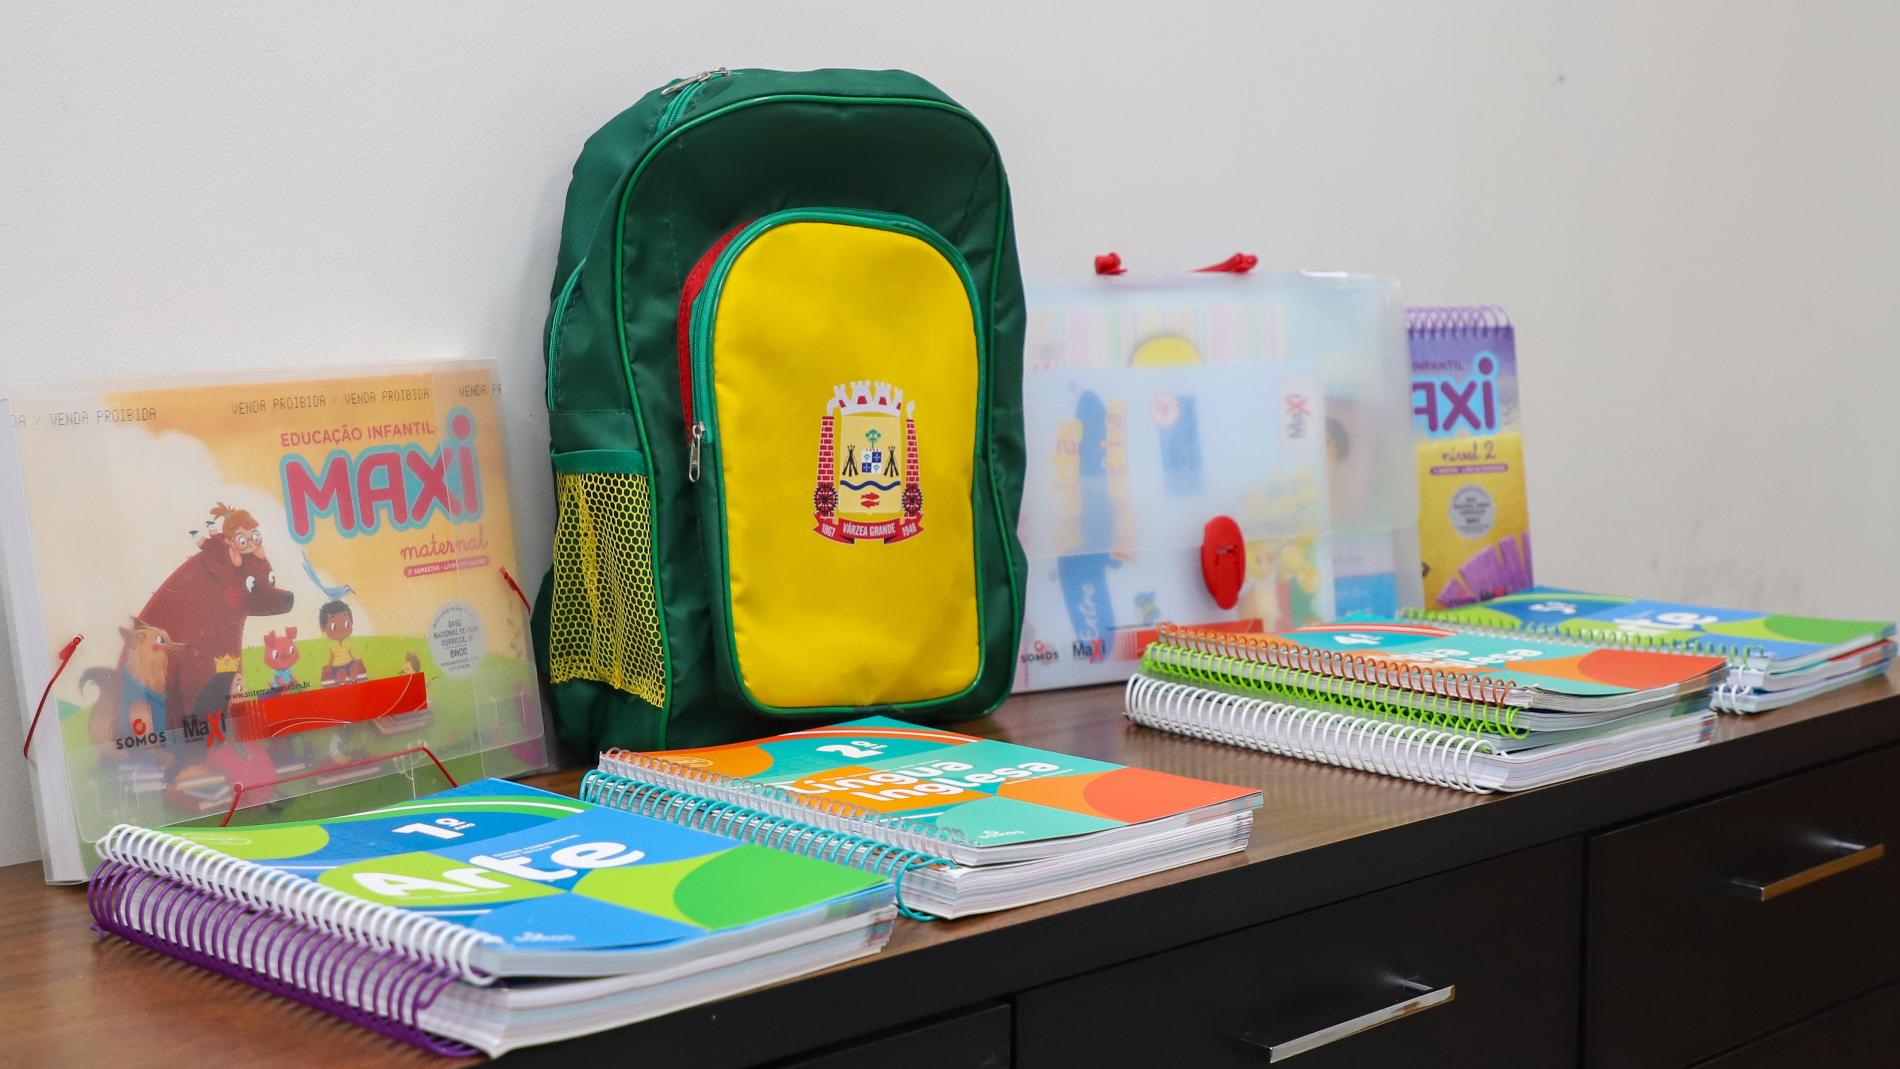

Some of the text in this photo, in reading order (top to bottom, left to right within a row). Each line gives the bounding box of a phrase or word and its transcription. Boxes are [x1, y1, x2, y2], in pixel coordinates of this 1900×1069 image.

[232, 400, 266, 415] VENDA
[272, 394, 326, 410] PROIBIDA
[344, 391, 377, 406] VENDA
[382, 387, 430, 404] PROIBIDA
[459, 384, 488, 398] VENDA
[50, 411, 89, 426] VENDA
[96, 407, 157, 425] PROIBIDA
[280, 420, 436, 448] EDUCAÇÃO INFANTIL
[400, 524, 489, 560] maternal
[843, 521, 868, 537] VÁRZEA
[869, 521, 897, 537] GRANDE
[116, 731, 168, 750] SOMOS
[850, 762, 1061, 802] Inglesa
[351, 841, 646, 897] Arte
